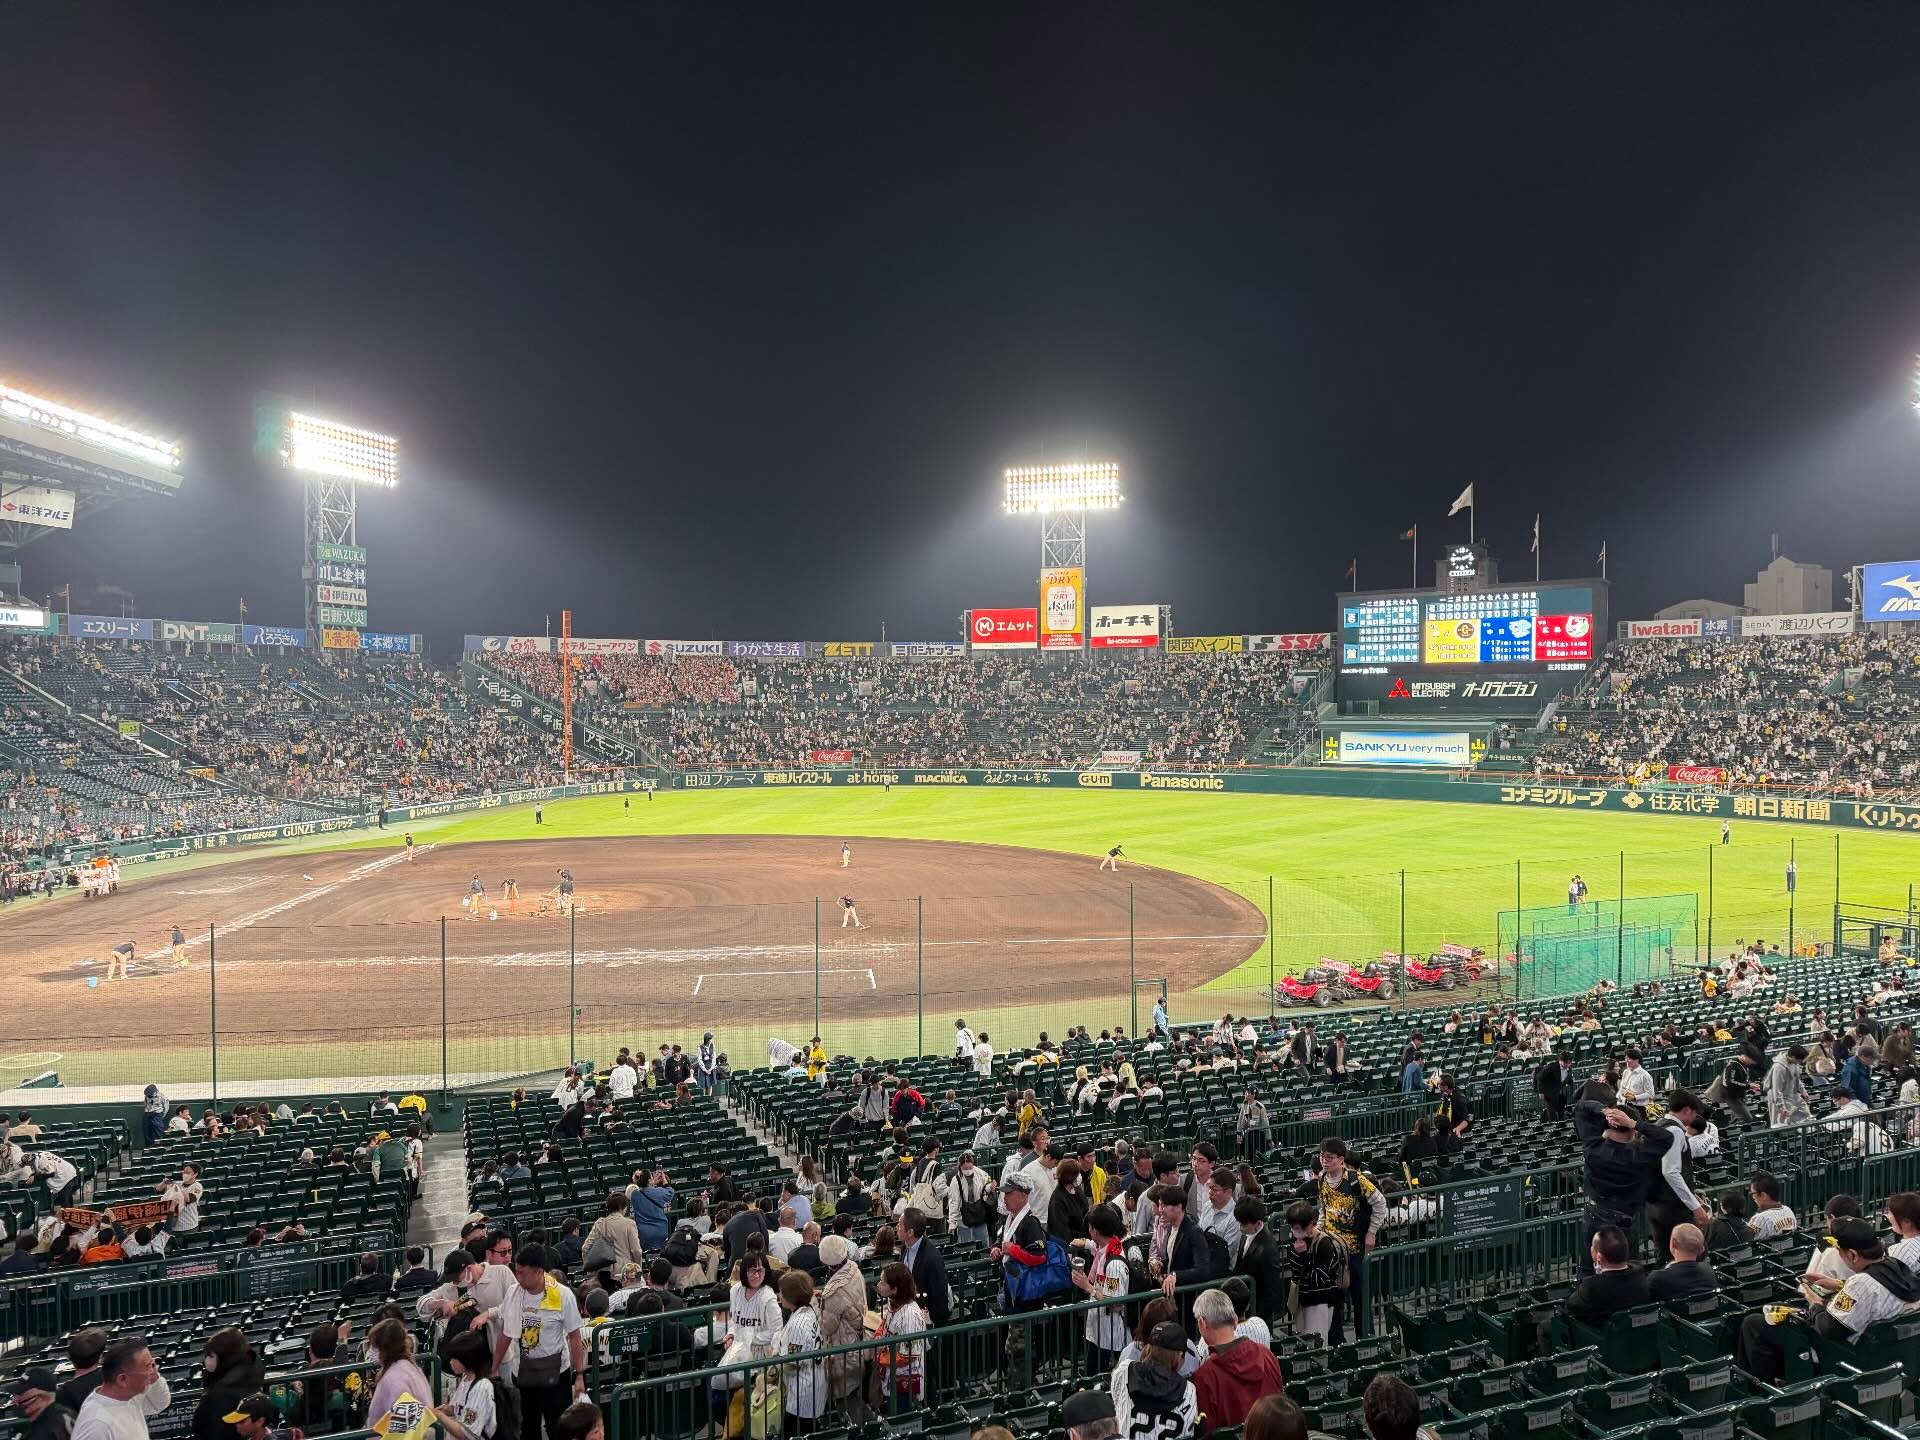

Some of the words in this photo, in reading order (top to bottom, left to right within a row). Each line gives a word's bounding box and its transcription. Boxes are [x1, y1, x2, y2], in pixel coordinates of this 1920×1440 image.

[18, 504, 70, 521] 東洋アルミ
[331, 548, 365, 562] WAZUKA
[320, 565, 366, 584] 川上塗料
[1048, 600, 1074, 612] Asahi
[321, 609, 364, 625] 日新火災
[1096, 615, 1155, 628] ホーチキ
[1779, 616, 1850, 631] 渡辺パイプ
[83, 621, 140, 636] エスリード
[996, 621, 1034, 632] エムット
[1631, 621, 1699, 637] Iwatani
[1705, 619, 1728, 630] 水素
[163, 623, 209, 641] DNT
[332, 632, 359, 648] 黄桜
[510, 639, 536, 652] 白鶴
[560, 641, 637, 652] ホテルニューアワジ
[1167, 638, 1242, 653] 関西ペイント
[1278, 634, 1331, 650] SSK
[665, 642, 720, 655] SUZUKI
[733, 642, 801, 656] わかさ生活
[823, 642, 874, 656] ZETT
[895, 645, 961, 656] 三和シャッター
[477, 675, 522, 708] 大同生命
[1411, 682, 1456, 690] MITSUBISHI
[1461, 681, 1539, 697] オーロラビジョン
[1411, 690, 1450, 698] ELECTRIC
[1345, 742, 1407, 752] SANKYU
[1408, 744, 1434, 755] very
[1435, 743, 1464, 753] much
[763, 772, 833, 784] 東進ハイスクール
[847, 773, 861, 783] at
[863, 772, 899, 783] home
[1140, 774, 1224, 790] Panasonic
[1676, 767, 1718, 783] Coca-Cola
[1501, 787, 1608, 806] コナミグループ
[1648, 793, 1720, 813] 住友化学
[1733, 797, 1831, 821] 朝日新聞
[282, 823, 316, 837] GUNZE
[181, 833, 228, 850] 大和証券
[612, 1325, 648, 1336] アイビーシート
[623, 1335, 639, 1345] 11段
[621, 1344, 639, 1353] 90番
[1130, 1406, 1185, 1440] 22
